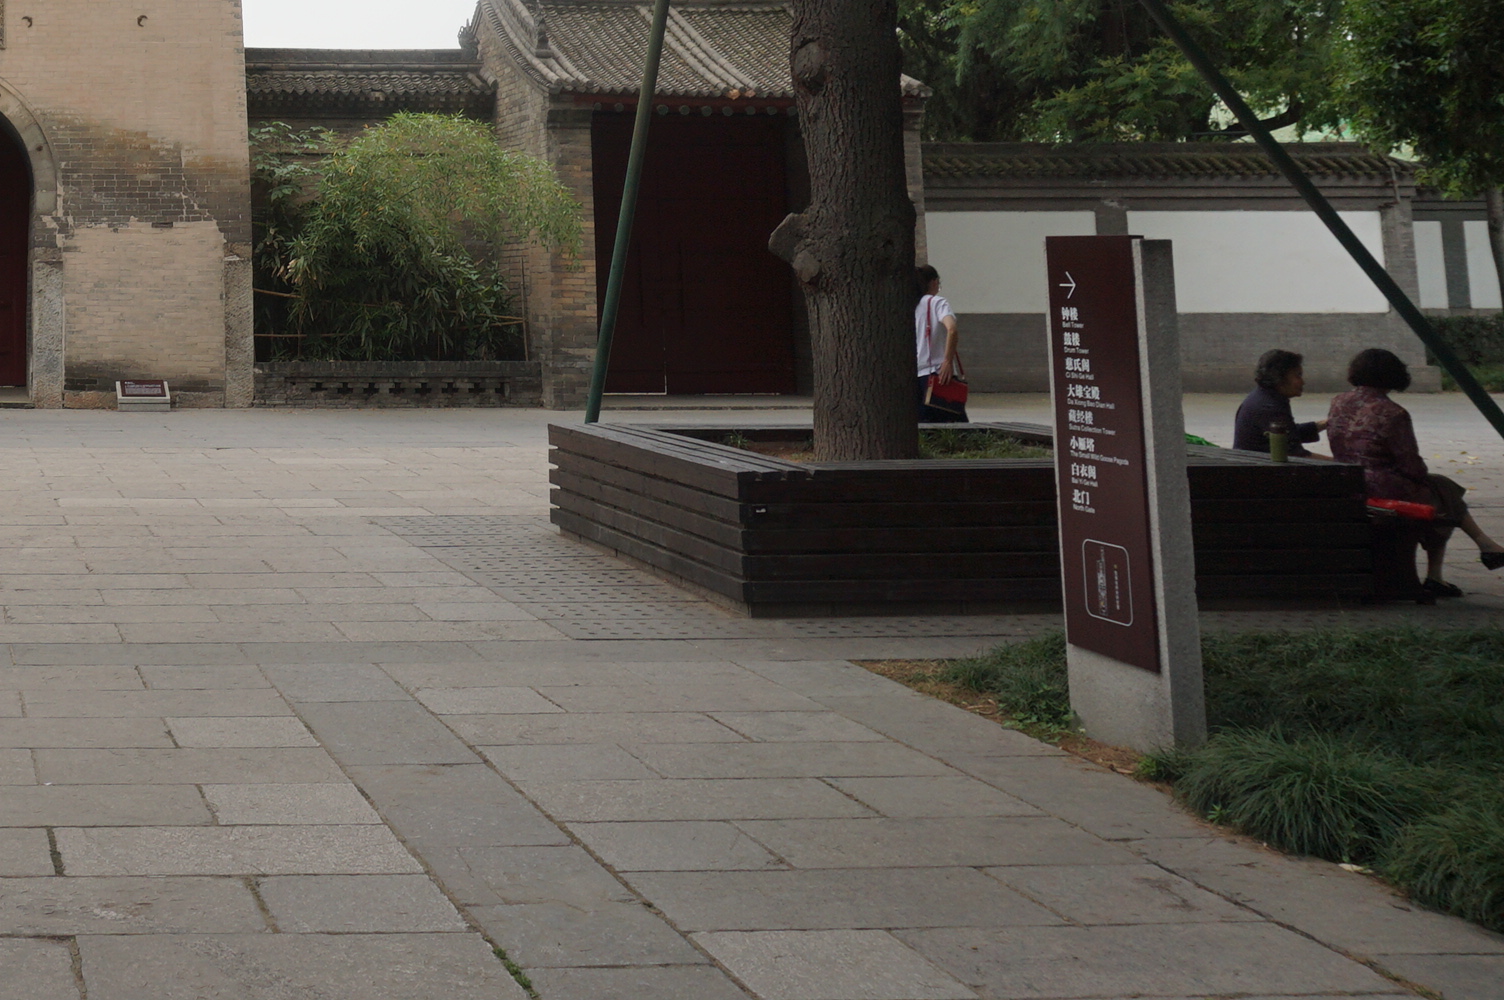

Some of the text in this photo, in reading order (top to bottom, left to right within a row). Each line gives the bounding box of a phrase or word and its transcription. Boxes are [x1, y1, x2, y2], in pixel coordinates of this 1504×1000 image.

[1061, 306, 1078, 321] 钟楼
[1064, 331, 1080, 346] 鼓楼
[1065, 357, 1090, 372] 慈氏阁
[1067, 383, 1100, 400] 大雄宝殿
[1069, 409, 1093, 425] 藏经楼
[1070, 436, 1094, 452] 小雁塔
[1071, 463, 1096, 479] 白衣阁
[1072, 489, 1089, 505] 北门
